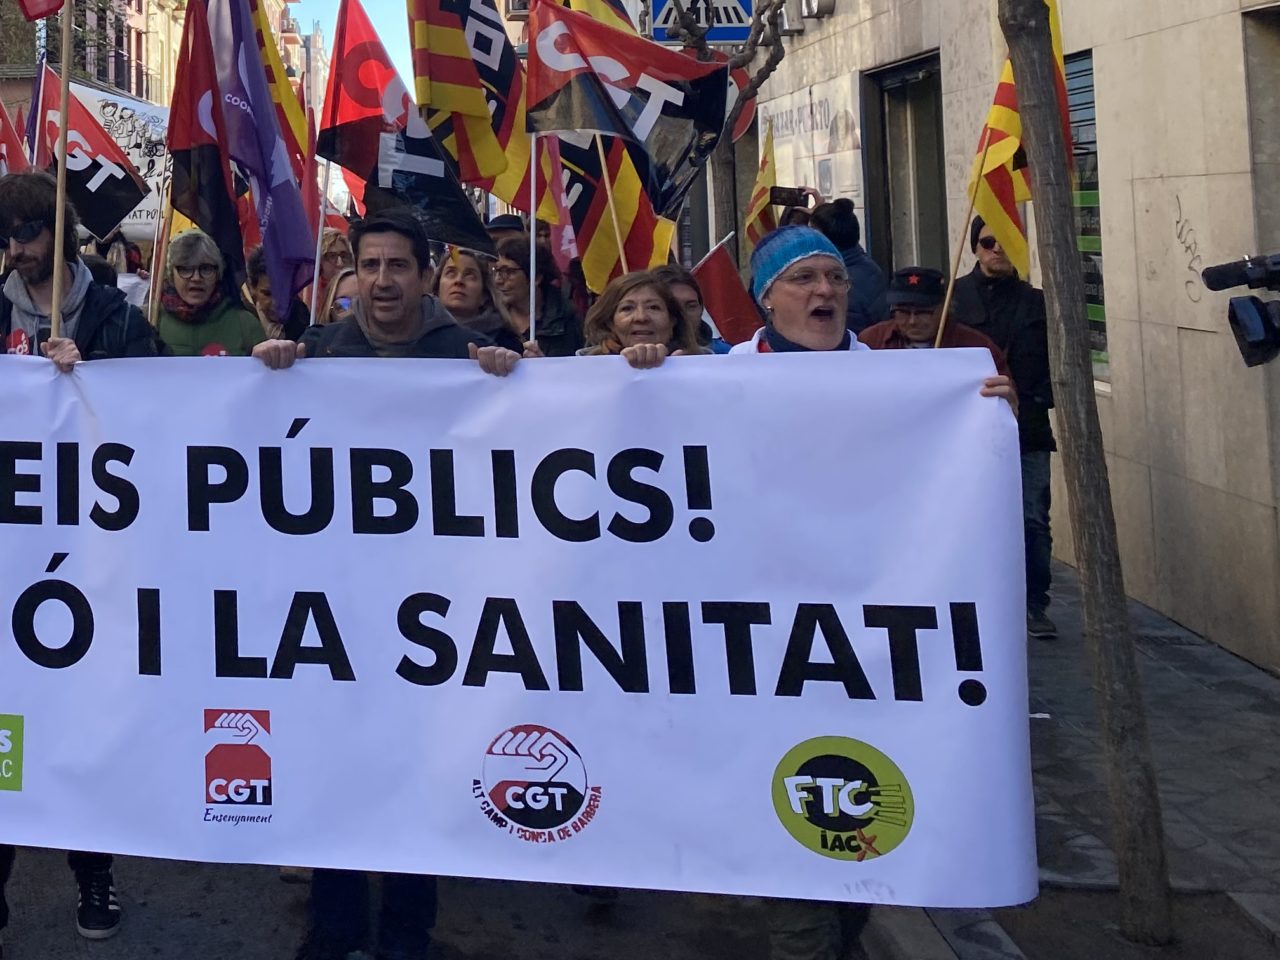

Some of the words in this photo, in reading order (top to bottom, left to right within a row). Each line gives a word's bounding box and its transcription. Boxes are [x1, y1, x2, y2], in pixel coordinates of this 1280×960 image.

[185, 417, 716, 544] PÚBLICS!
[136, 587, 162, 677] I
[213, 589, 357, 682] LA
[395, 591, 988, 707] SANITAT!
[208, 778, 270, 804] CGT
[472, 778, 486, 800] ALT
[480, 800, 508, 829] CAMP
[505, 785, 569, 812] CGT
[783, 775, 875, 817] FTC
[203, 807, 273, 827] Ensenyament
